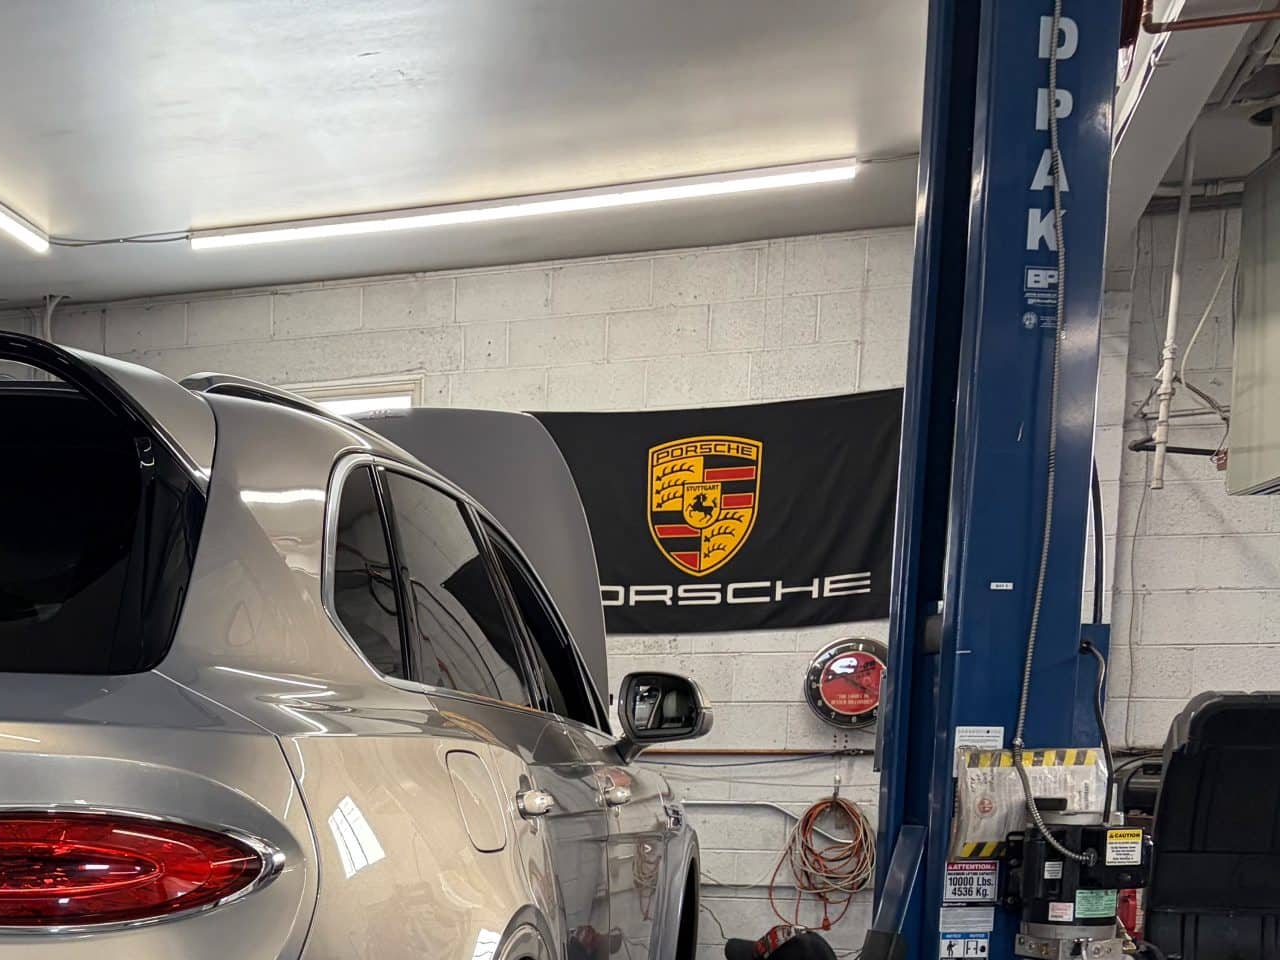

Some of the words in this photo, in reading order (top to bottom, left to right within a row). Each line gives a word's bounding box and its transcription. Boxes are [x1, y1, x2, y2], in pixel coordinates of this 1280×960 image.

[655, 442, 754, 465] PORSCHE
[686, 483, 719, 491] STUTTGART
[948, 876, 974, 886] 10000
[977, 876, 994, 886] Lbs.
[951, 887, 973, 896] 4536
